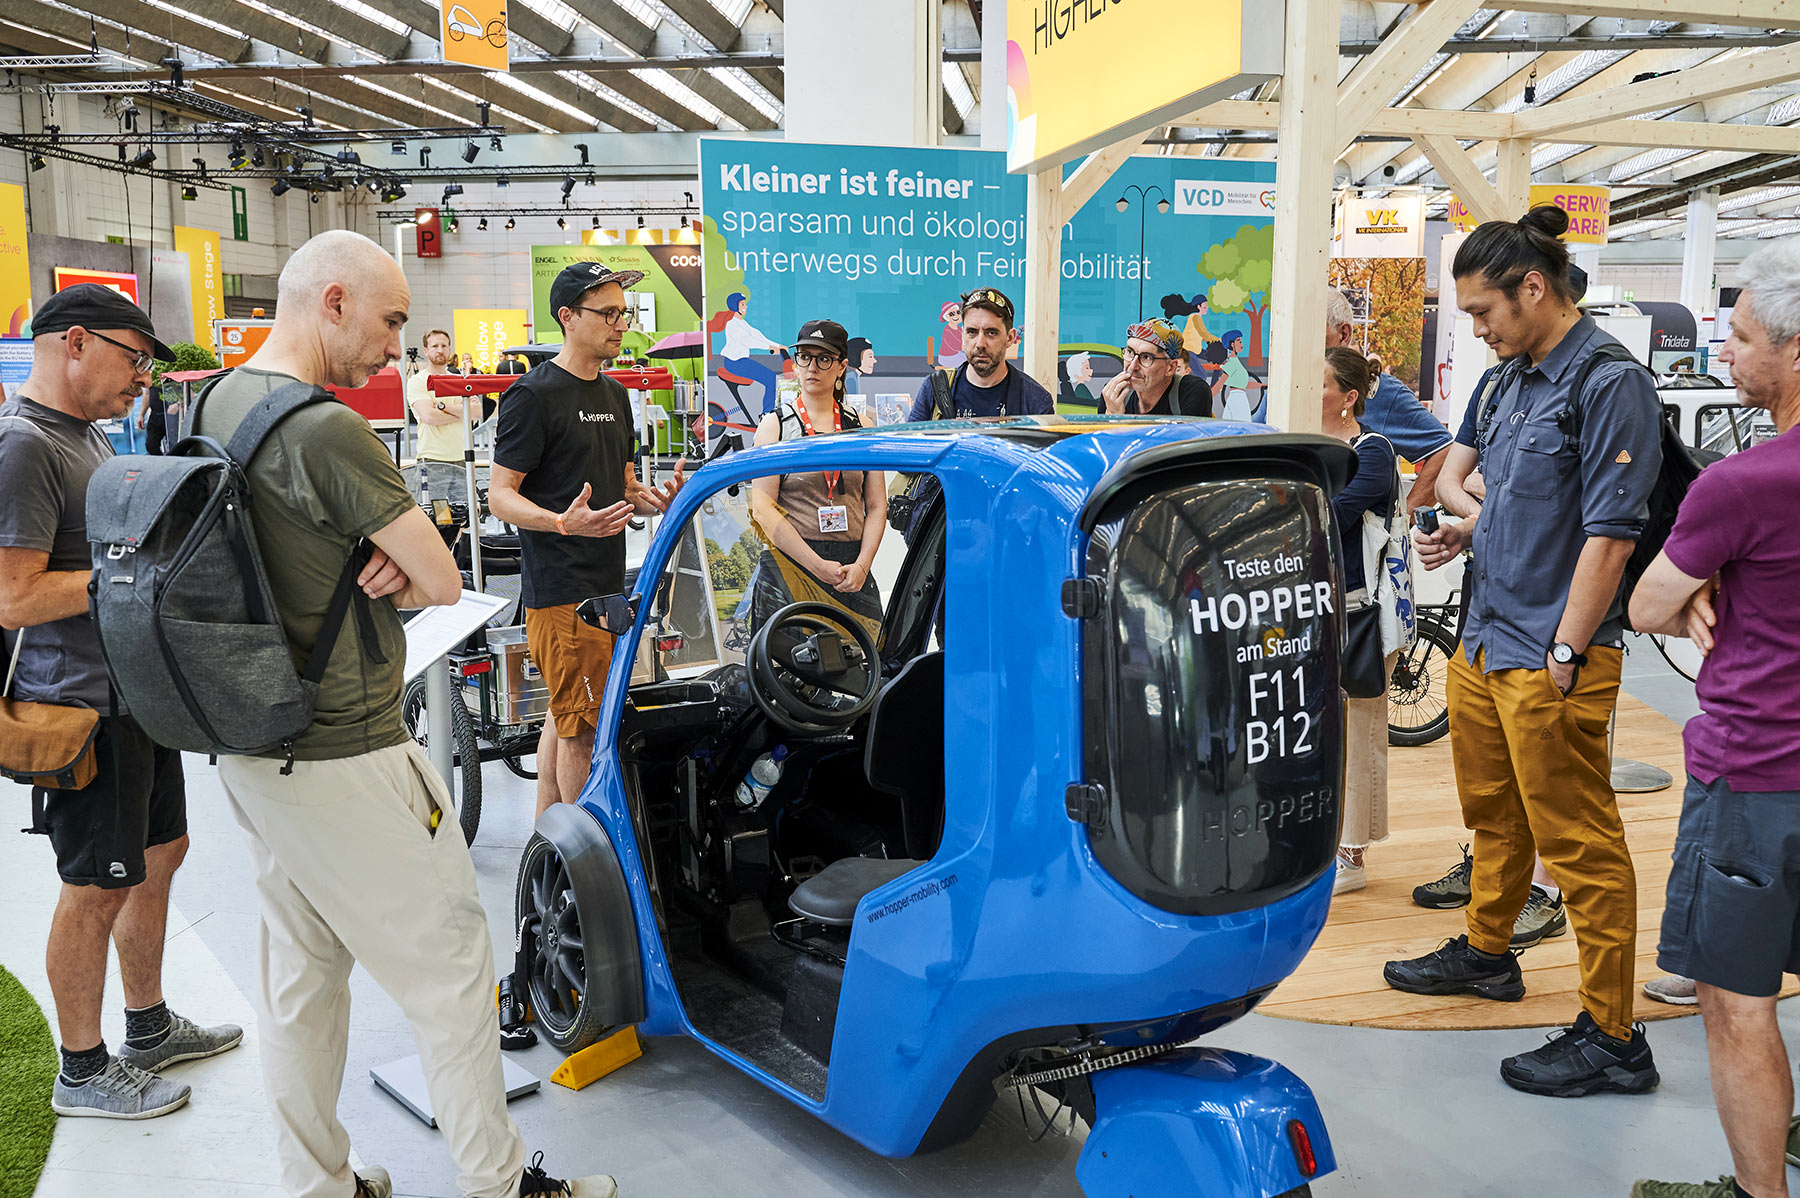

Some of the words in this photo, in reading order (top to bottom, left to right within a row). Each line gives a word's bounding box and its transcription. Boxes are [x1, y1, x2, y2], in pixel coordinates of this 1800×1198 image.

[1033, 0, 1121, 55] HIGH
[720, 163, 831, 194] Kleiner
[839, 167, 878, 196] ist
[885, 169, 974, 200] feiner
[1182, 188, 1225, 207] VCD
[722, 209, 851, 239] sparsam
[862, 209, 914, 237] und
[924, 210, 1073, 247] ökologi
[1365, 209, 1399, 226] VK
[1567, 217, 1605, 236] AREA
[421, 230, 435, 251] P
[204, 241, 215, 290] Stage
[534, 256, 559, 264] ENGEL
[724, 247, 878, 281] unterwegs
[887, 247, 966, 277] durch
[977, 251, 1152, 281] Feiobilität
[230, 333, 239, 342] 25
[475, 320, 489, 368] Yellow
[1660, 334, 1691, 348] Tridata
[587, 413, 616, 422] HOPPER
[1224, 559, 1271, 581] Teste
[1274, 553, 1304, 575] den
[1190, 581, 1334, 635] HOPPER
[1236, 642, 1264, 664] am
[1266, 631, 1311, 659] Stand
[1248, 665, 1306, 717] F11
[1245, 711, 1313, 765] B12
[1202, 785, 1333, 843] HOPPER
[866, 873, 959, 924] www.hopper-mobility.com
